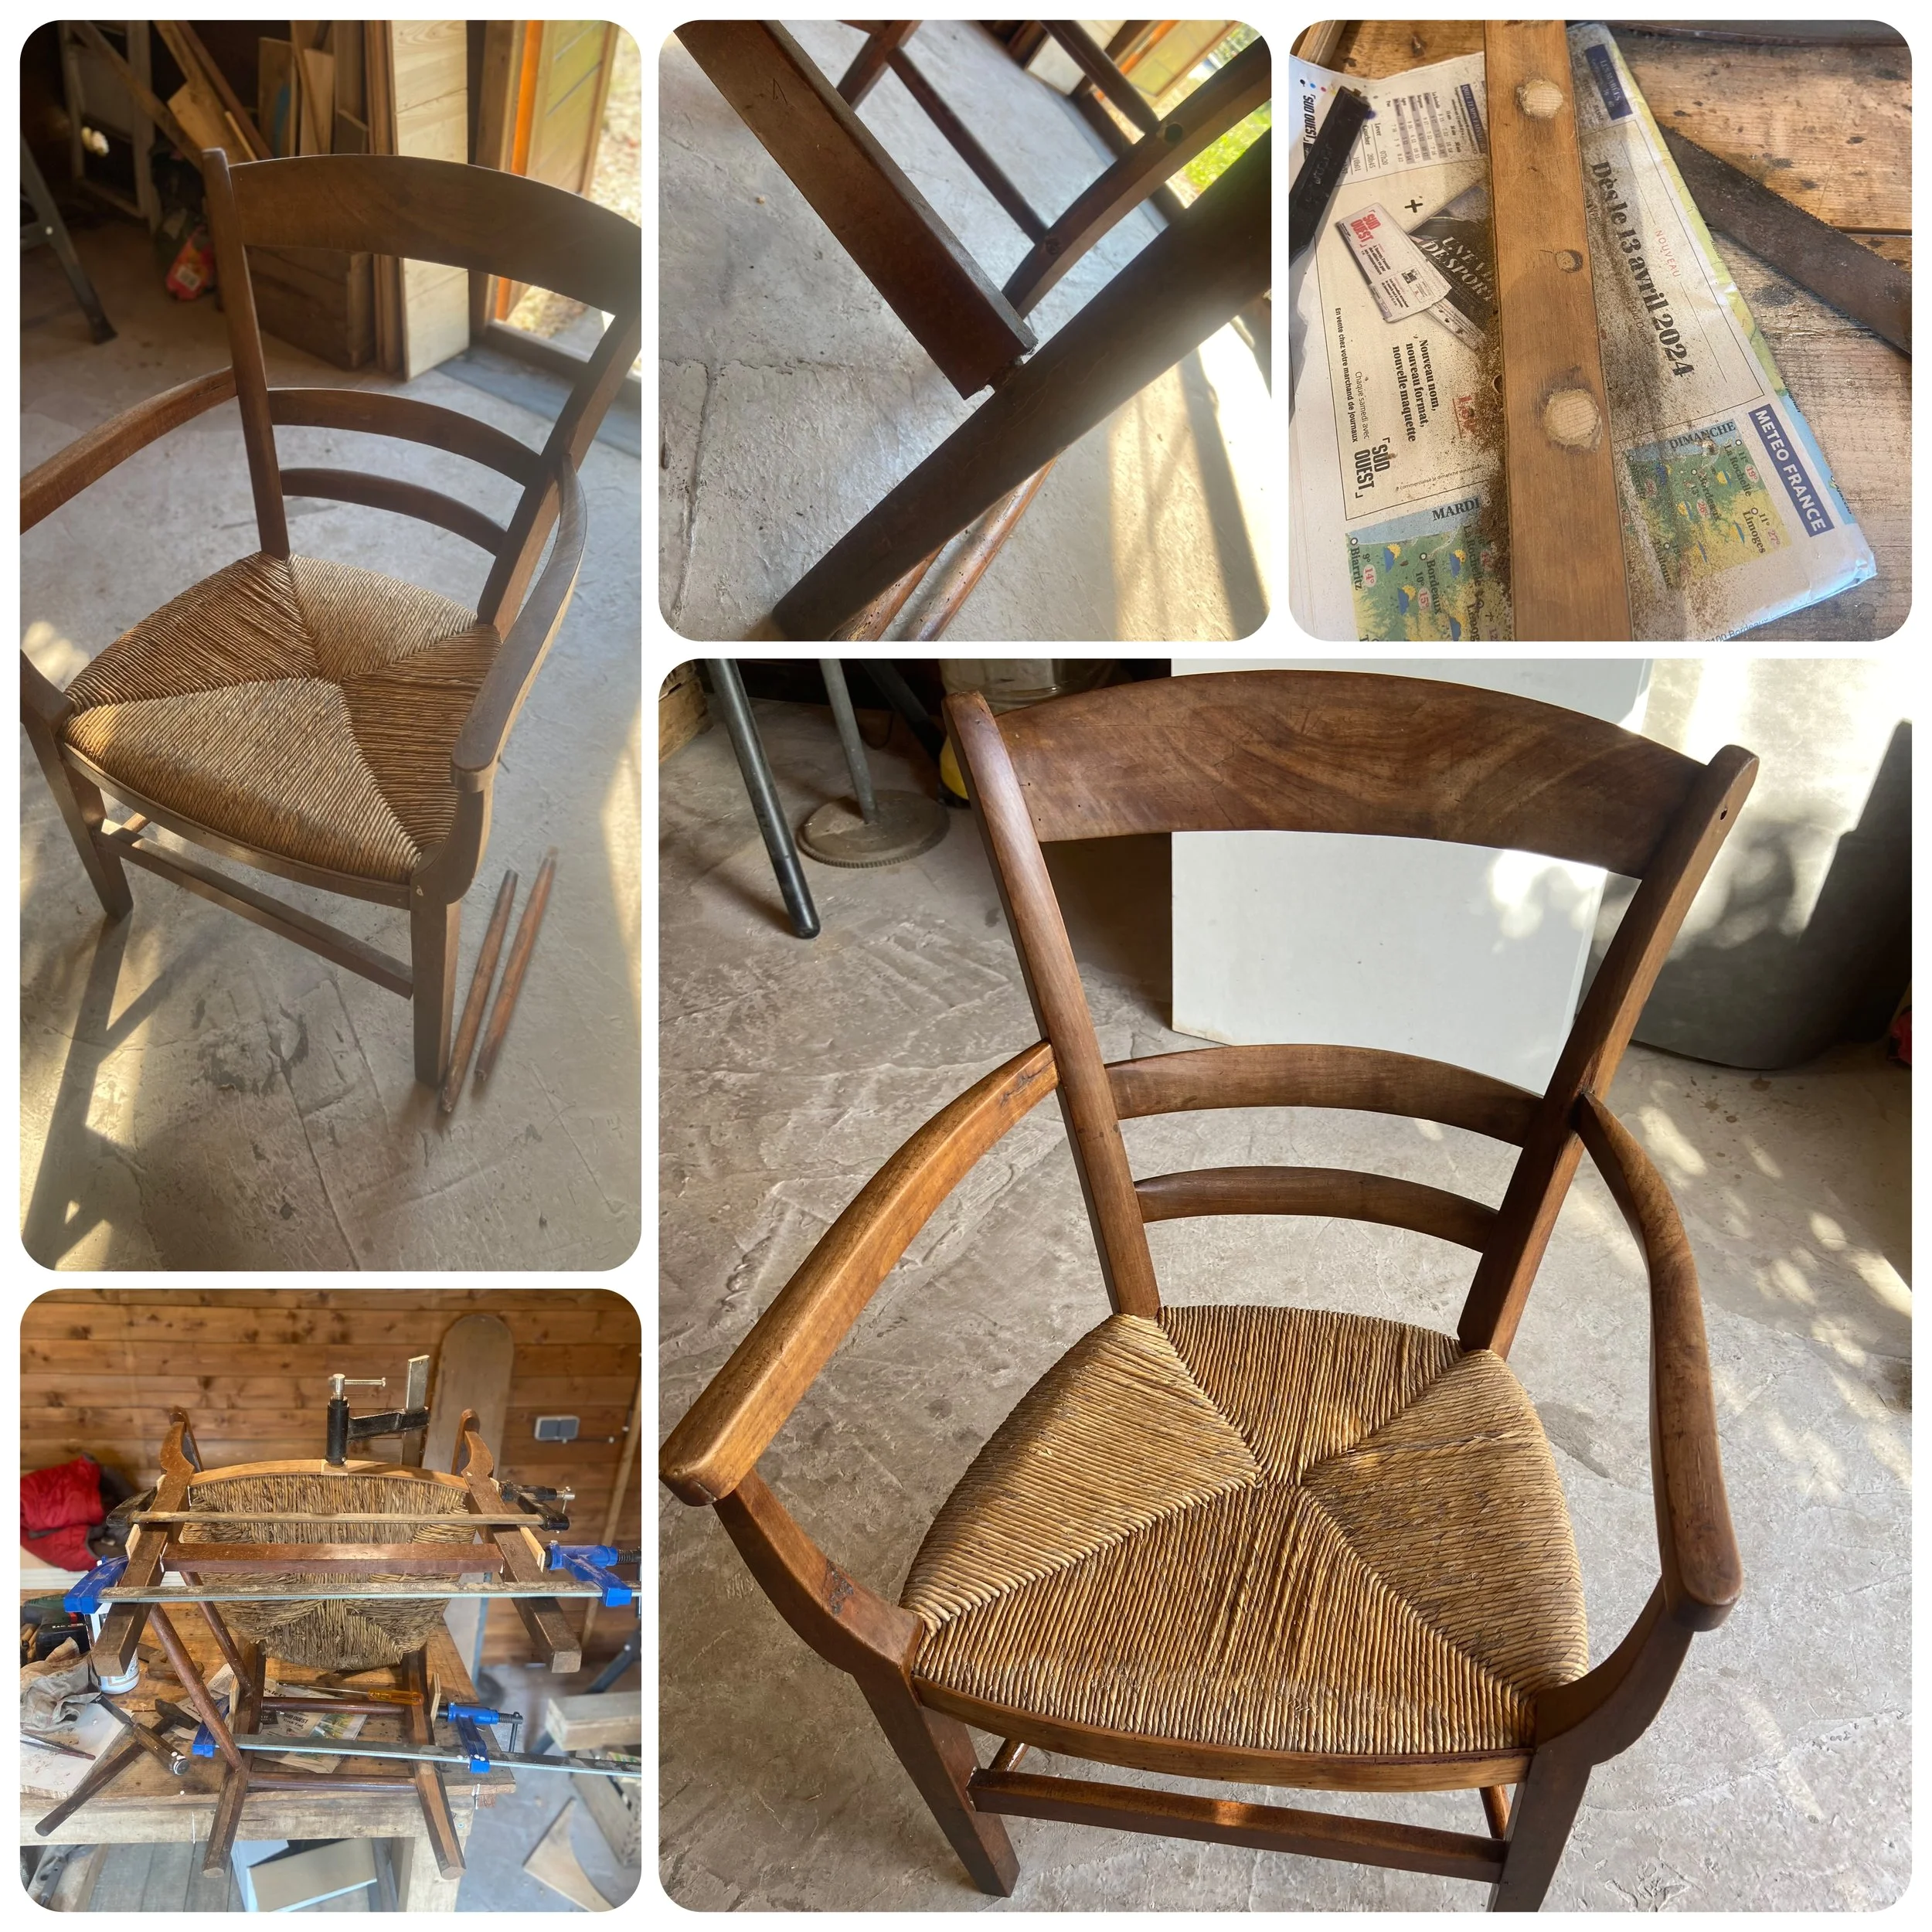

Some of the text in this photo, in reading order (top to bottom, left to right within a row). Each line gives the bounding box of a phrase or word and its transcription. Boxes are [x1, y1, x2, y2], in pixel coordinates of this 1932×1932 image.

[1303, 95, 1315, 114] SUD
[1304, 113, 1317, 139] OUEST
[1362, 124, 1371, 145] Coucher
[1591, 162, 1617, 202] Dès
[1362, 213, 1381, 230] SUD
[1607, 201, 1628, 225] le
[1350, 219, 1374, 243] OUEST
[1617, 227, 1641, 253] 13
[1420, 240, 1449, 260] DE
[1442, 236, 1477, 261] UNE
[1655, 230, 1682, 277] NOUVEAU
[1628, 256, 1669, 314] avril
[1335, 307, 1342, 316] En
[1635, 321, 1650, 346] Ouest
[1652, 313, 1695, 378] 2024
[1343, 367, 1353, 400] marchand
[1406, 342, 1429, 427] nouveau format,
[1419, 338, 1440, 411] Nouveau nom,
[1348, 401, 1355, 410] de
[1355, 371, 1363, 397] Chaque
[1359, 397, 1369, 423] samedi
[1392, 345, 1417, 442] nouvelle maquette
[1347, 410, 1359, 443] journaux
[1669, 421, 1736, 449] DIMANCHE
[1354, 449, 1375, 490] OUEST
[1372, 444, 1390, 472] SUD
[1738, 451, 1749, 463] 11°
[1400, 478, 1431, 490] commercialisé
[1437, 471, 1459, 480] dimanche
[1723, 444, 1752, 497] La Rochelle
[1746, 465, 1758, 481] 19°
[1755, 410, 1827, 532] METEO FRANCE
[1432, 497, 1481, 522] MARDI
[1758, 512, 1770, 526] 11°
[1742, 511, 1766, 554] Limoges
[1767, 527, 1781, 545] 27°
[1350, 547, 1363, 591] Biarritz
[1362, 553, 1371, 563] 9°
[1365, 567, 1375, 583] 14°
[1416, 572, 1425, 587] 10°
[1426, 560, 1442, 615] Bordeaux
[1419, 591, 1429, 607] 15°
[293, 1716, 308, 1724] OUEST
